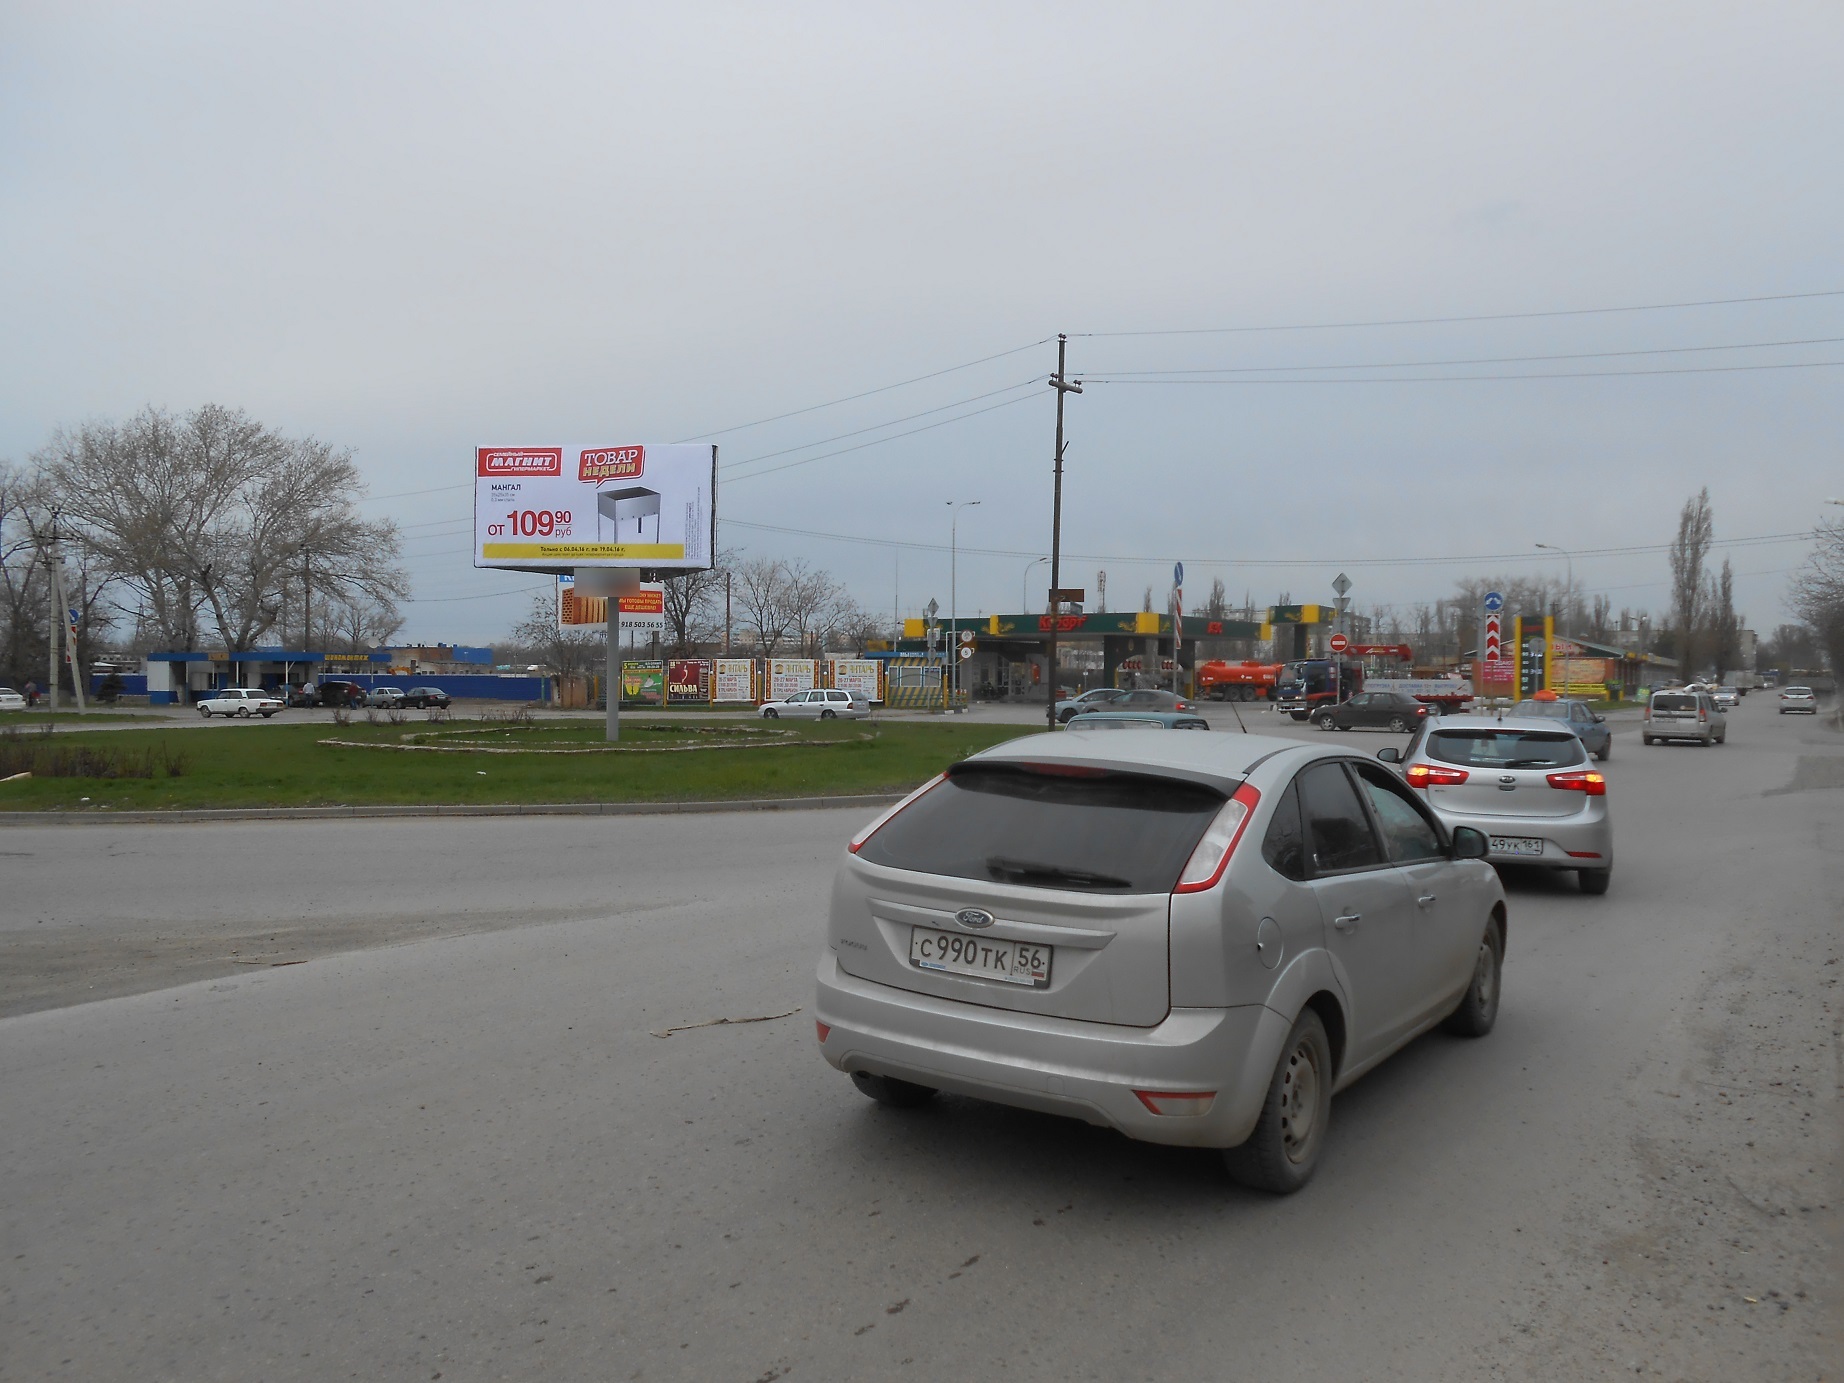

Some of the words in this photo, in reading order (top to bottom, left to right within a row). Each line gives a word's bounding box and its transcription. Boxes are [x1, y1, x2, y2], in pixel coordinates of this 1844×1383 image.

[491, 457, 553, 466] МАГНИТ
[584, 450, 638, 466] ТОВАР
[583, 463, 635, 477] НЕДЕЛИ
[507, 510, 554, 537] 109
[555, 510, 572, 523] 90
[555, 527, 572, 539] руб
[670, 684, 697, 693] СИЛЬВА
[1491, 839, 1519, 850] 49УК
[1523, 840, 1540, 848] 161
[963, 911, 984, 923] Ford
[1018, 947, 1042, 969] 56
[1014, 965, 1031, 975] RUS
